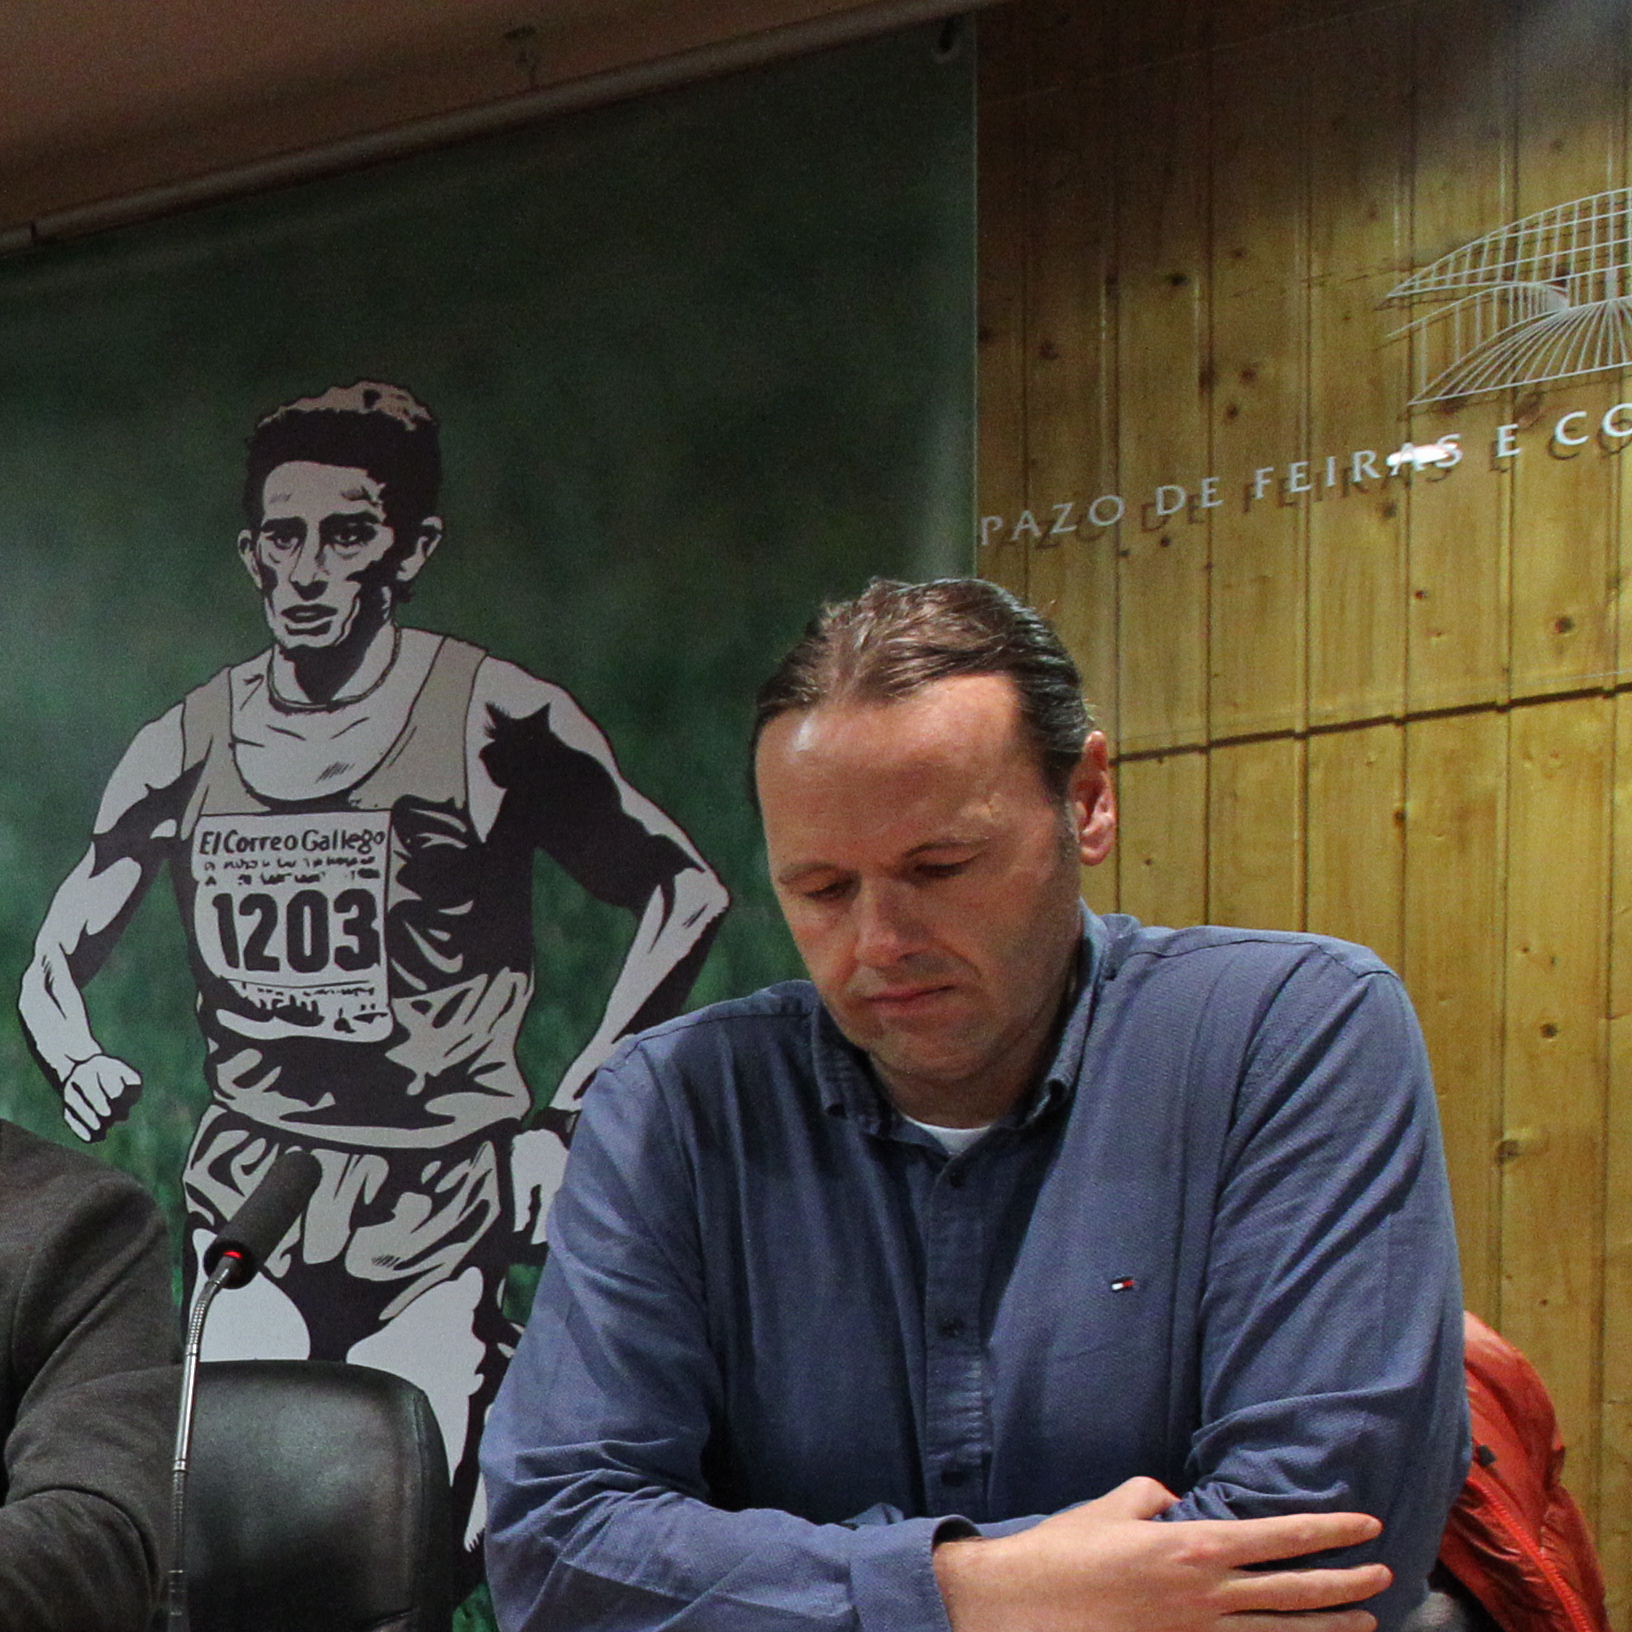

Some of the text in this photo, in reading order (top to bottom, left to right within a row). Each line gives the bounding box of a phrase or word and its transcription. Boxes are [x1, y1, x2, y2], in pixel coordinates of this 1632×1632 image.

[978, 494, 1126, 547] PAZO
[1154, 476, 1225, 517] DE
[1253, 432, 1464, 500] FEIRAS
[1495, 422, 1522, 458] E
[199, 828, 386, 855] El Correo Gallego
[212, 888, 381, 973] 1203
